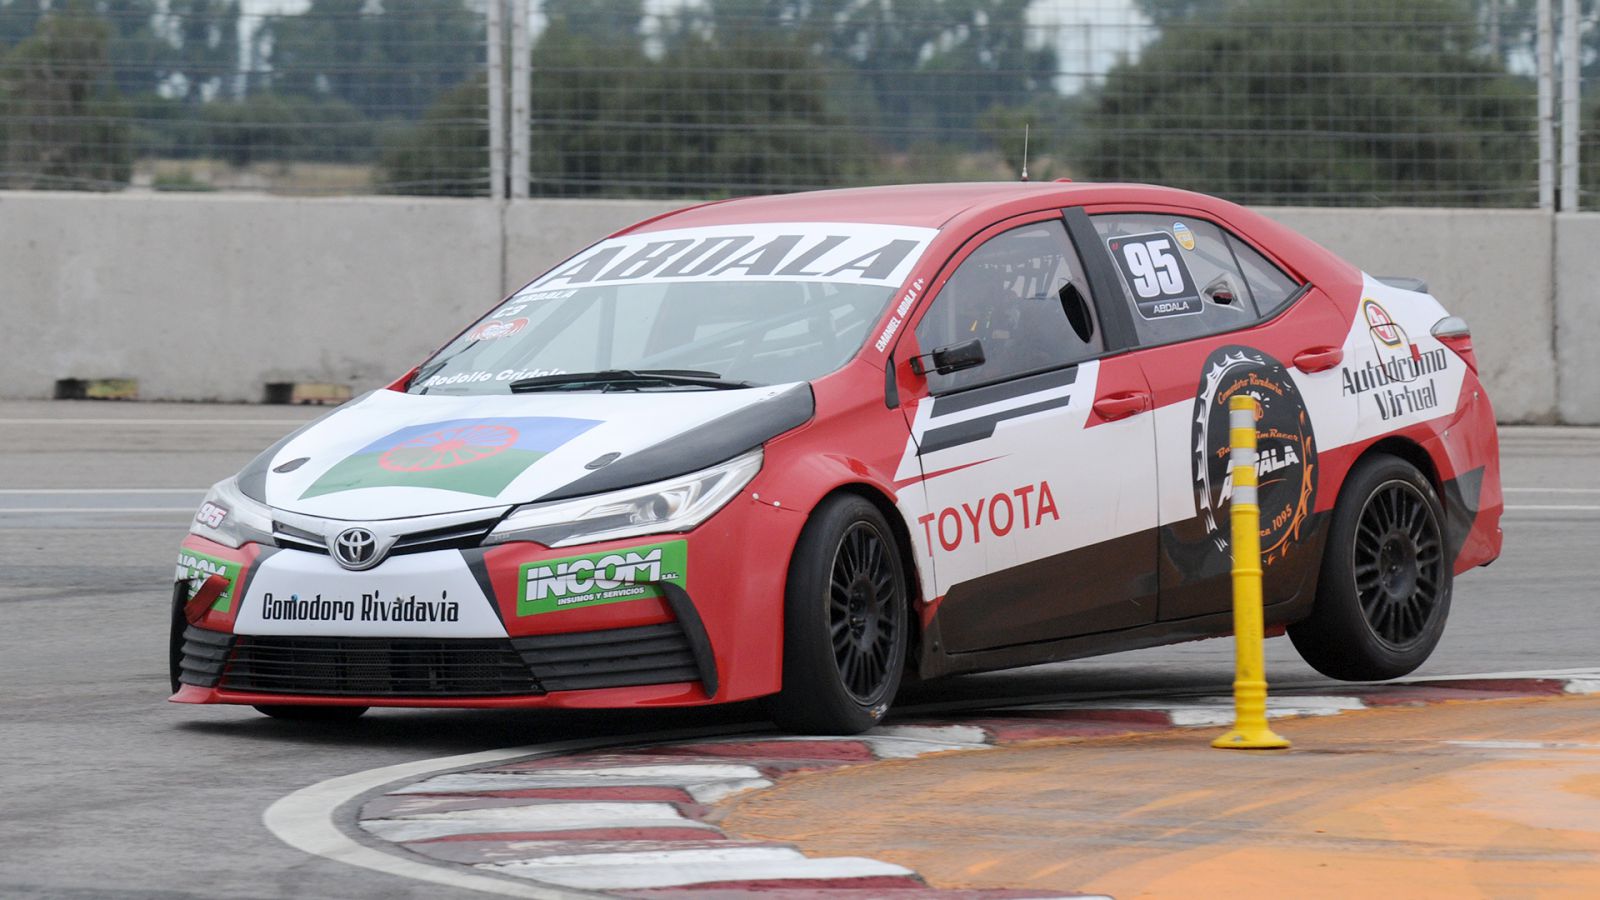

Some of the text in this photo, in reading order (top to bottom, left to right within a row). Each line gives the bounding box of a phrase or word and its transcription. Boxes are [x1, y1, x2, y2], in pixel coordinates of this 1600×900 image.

[531, 234, 921, 289] ABDALA
[1123, 239, 1185, 298] 95
[1153, 301, 1190, 314] ABDALA
[423, 371, 494, 387] Rodolfo
[1342, 348, 1448, 398] Autodromo
[1374, 378, 1438, 421] Virtual
[197, 502, 228, 528] 95
[918, 480, 1060, 557] TOYOTA
[525, 549, 662, 601] INCOM
[557, 587, 645, 606] INSUMOS Y SERVICIOS
[263, 590, 459, 622] Comodoro Rivadavia
